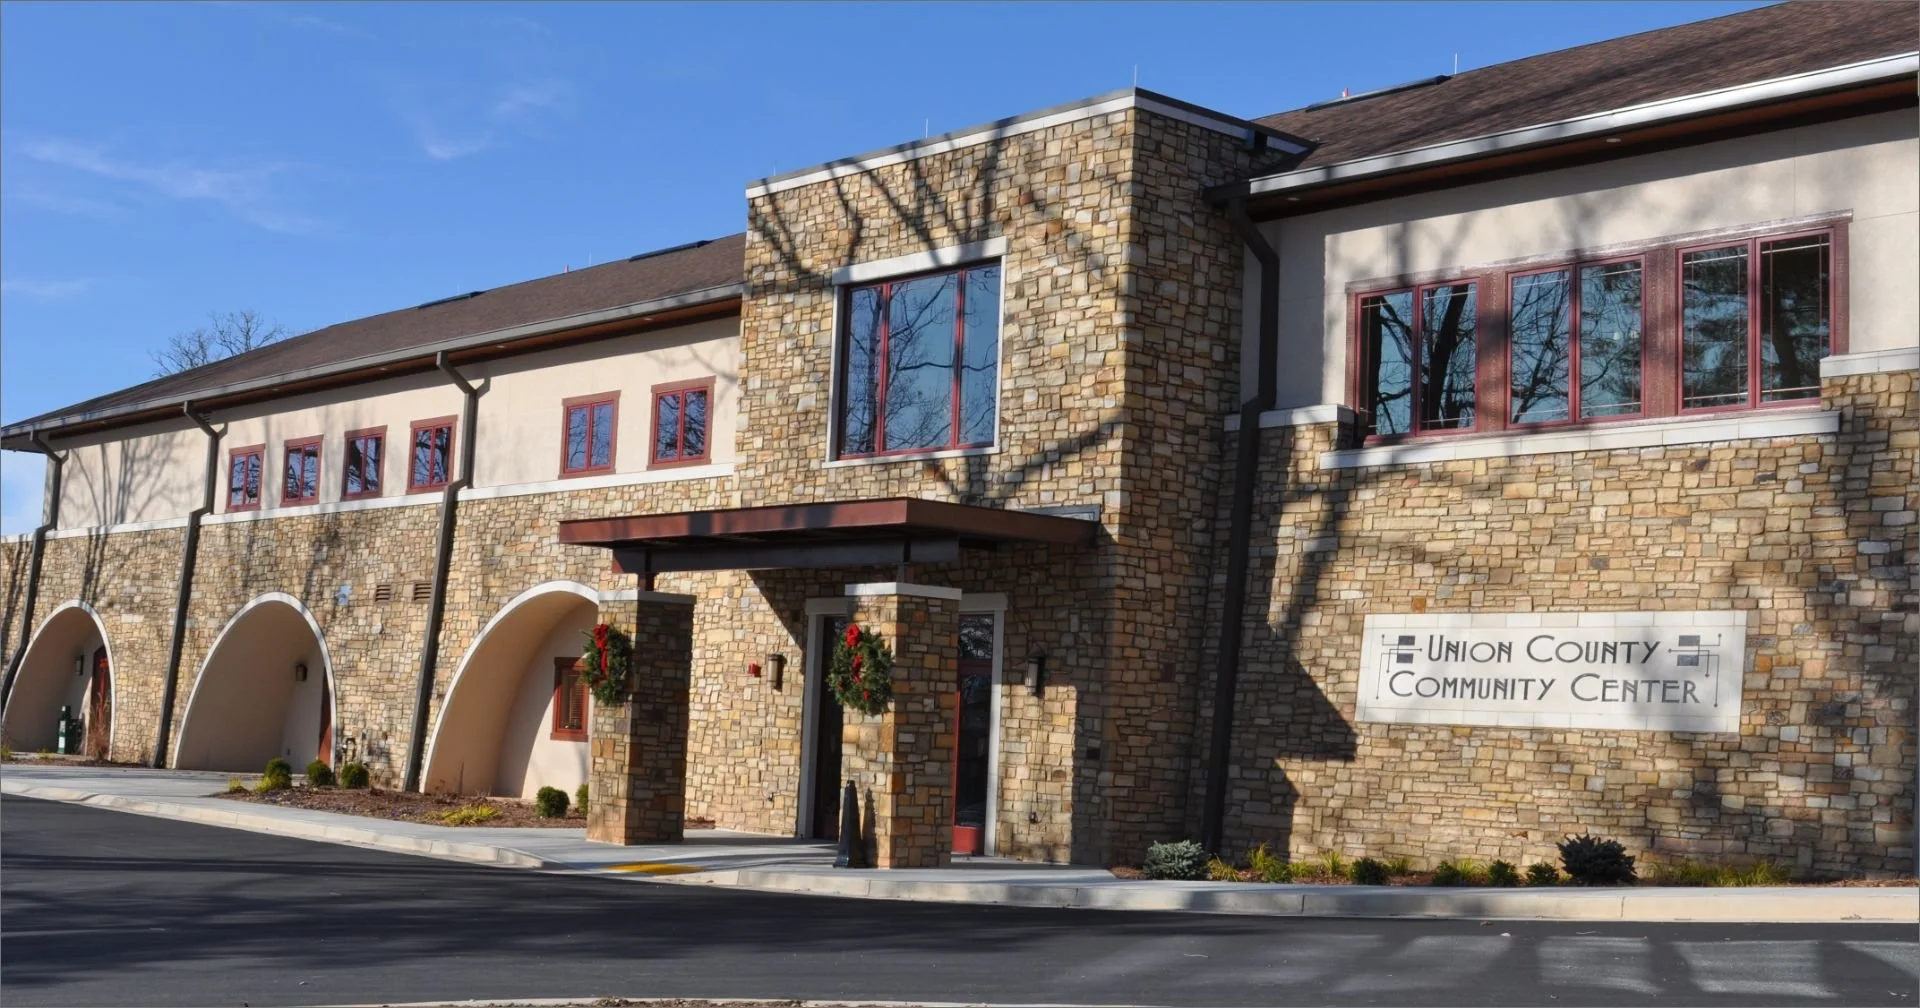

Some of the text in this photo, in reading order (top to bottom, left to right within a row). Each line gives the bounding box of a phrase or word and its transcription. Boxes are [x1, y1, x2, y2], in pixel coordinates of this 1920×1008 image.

[1428, 634, 1661, 664] UNION COUNTY
[1388, 670, 1701, 704] COMMUNITY CENTER
